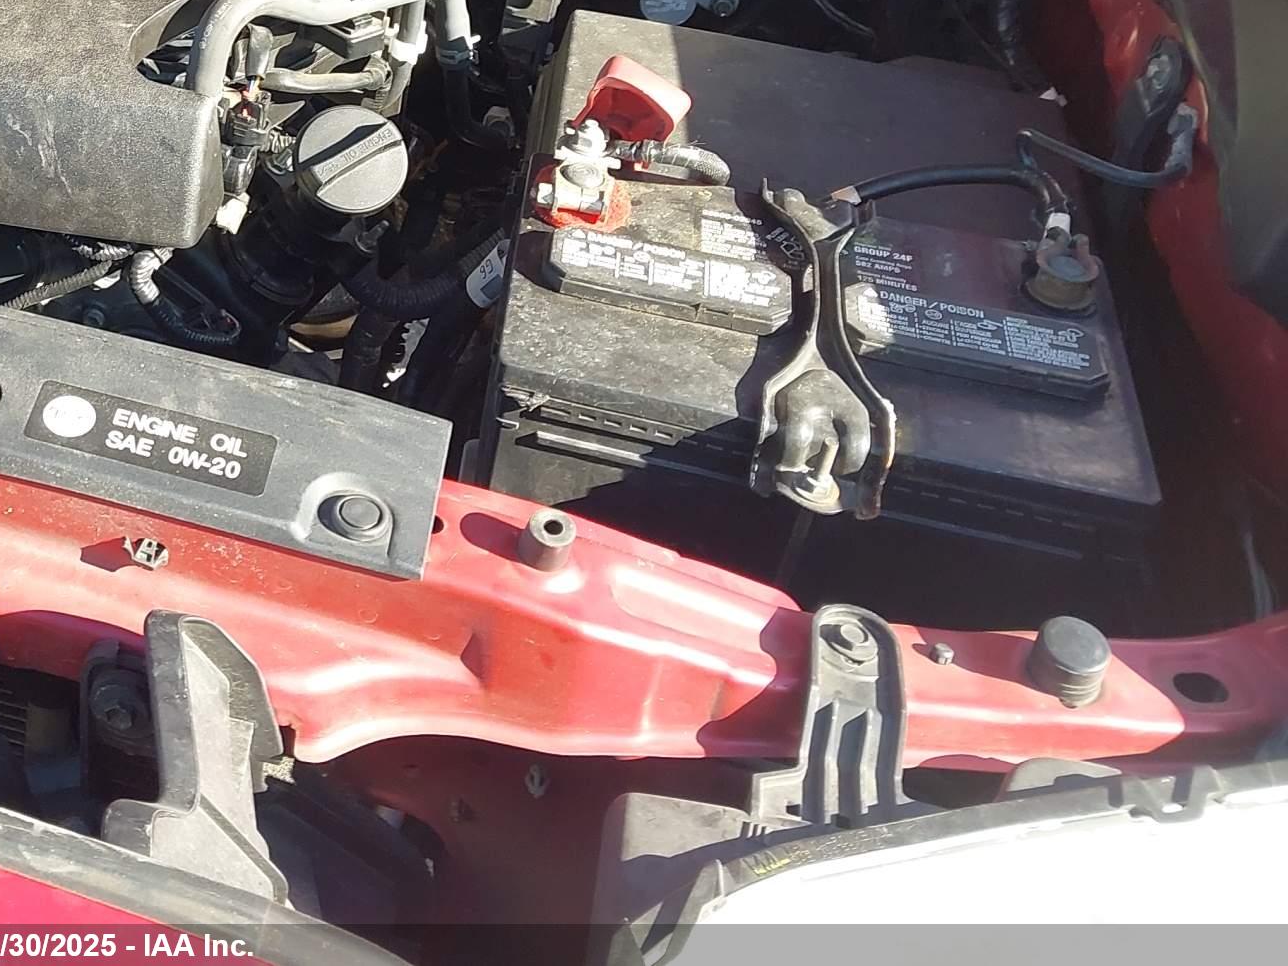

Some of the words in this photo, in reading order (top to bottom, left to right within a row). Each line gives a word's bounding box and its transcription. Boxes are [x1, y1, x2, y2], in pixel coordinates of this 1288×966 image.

[854, 246, 891, 258] GROUP
[879, 290, 928, 308] DANGER
[940, 302, 985, 319] POISON
[112, 408, 199, 444] ENGINE
[210, 432, 248, 458] OIL
[105, 430, 156, 458] SAE
[167, 445, 242, 480] 0W-20
